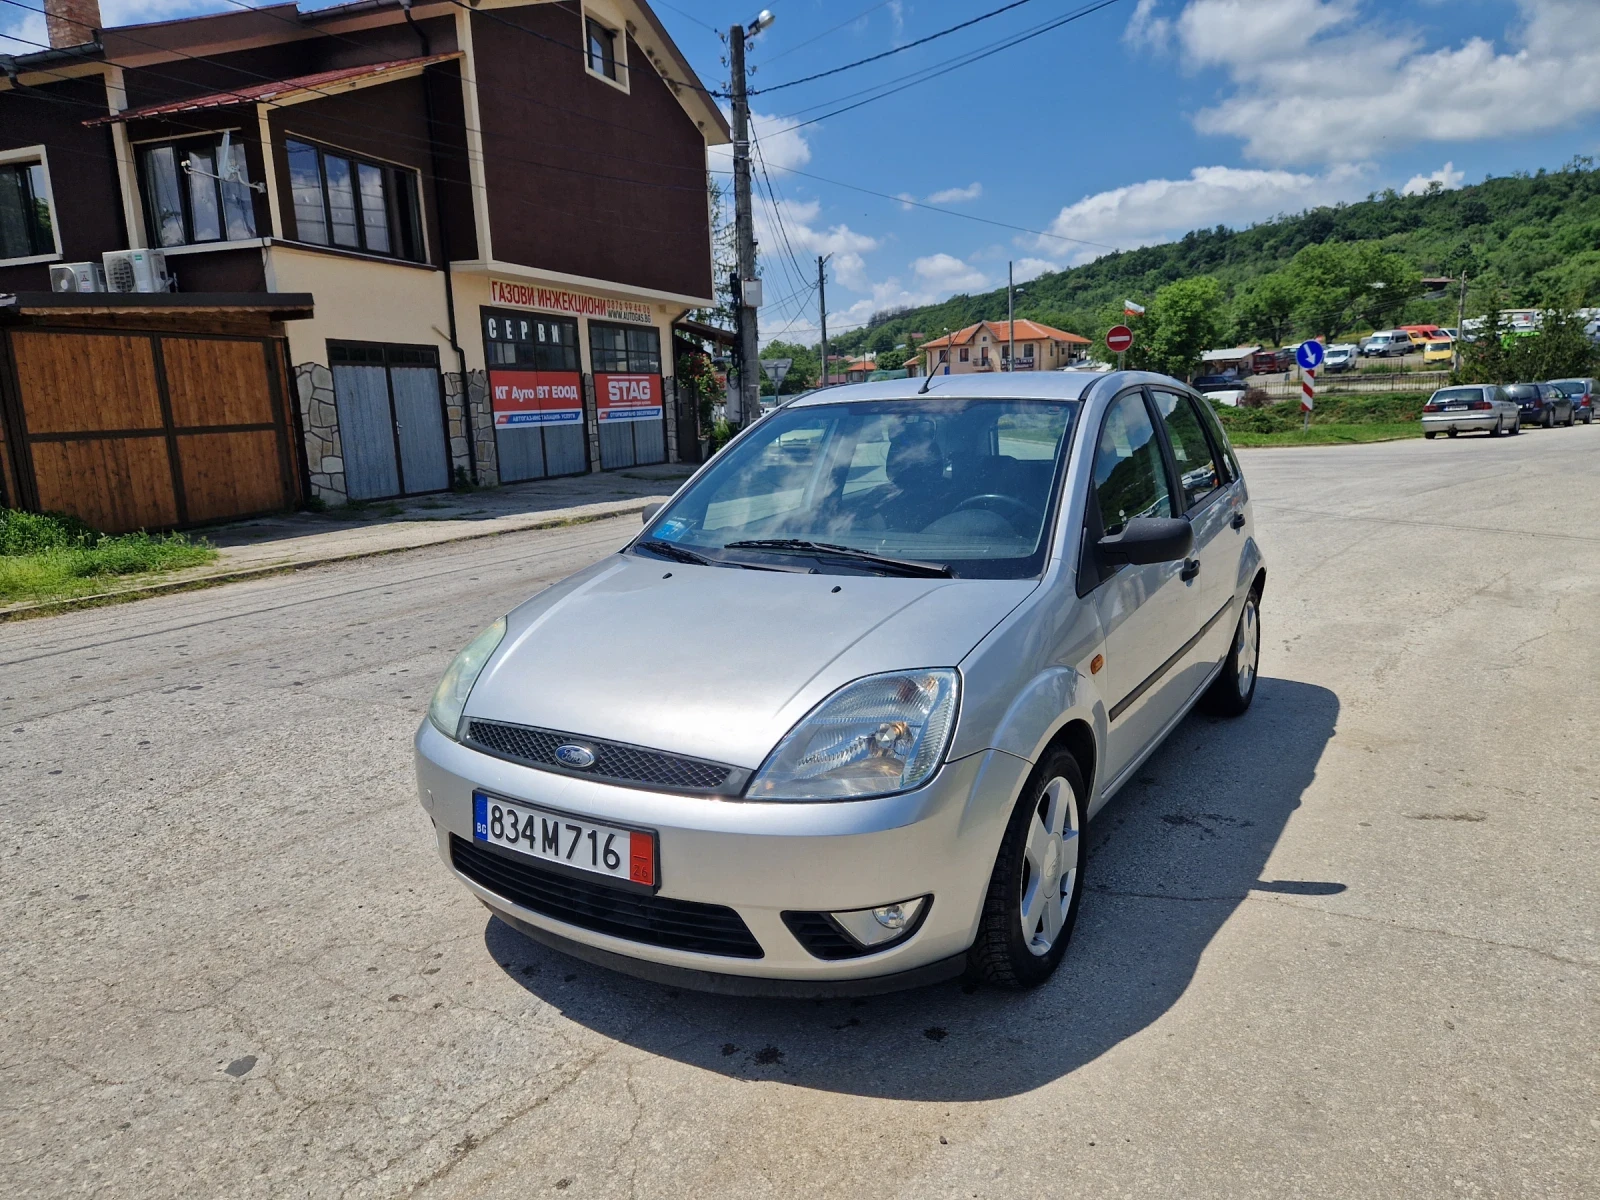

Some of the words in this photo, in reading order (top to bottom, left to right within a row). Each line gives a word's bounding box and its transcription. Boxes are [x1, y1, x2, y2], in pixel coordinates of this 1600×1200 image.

[491, 281, 535, 306] ГАЗОВИ
[537, 288, 606, 316] ИНЖЕКЦИОНИ
[607, 309, 651, 323] WWW.AUTOGAS.BG
[495, 386, 508, 399] КГ
[512, 386, 534, 402] Ауто
[537, 386, 549, 399] ВТ
[552, 386, 578, 400] ЕООД
[608, 381, 650, 400] STAG
[560, 747, 584, 764] Ford
[477, 822, 487, 835] BG
[490, 804, 620, 870] 834M716
[633, 864, 648, 878] 26
